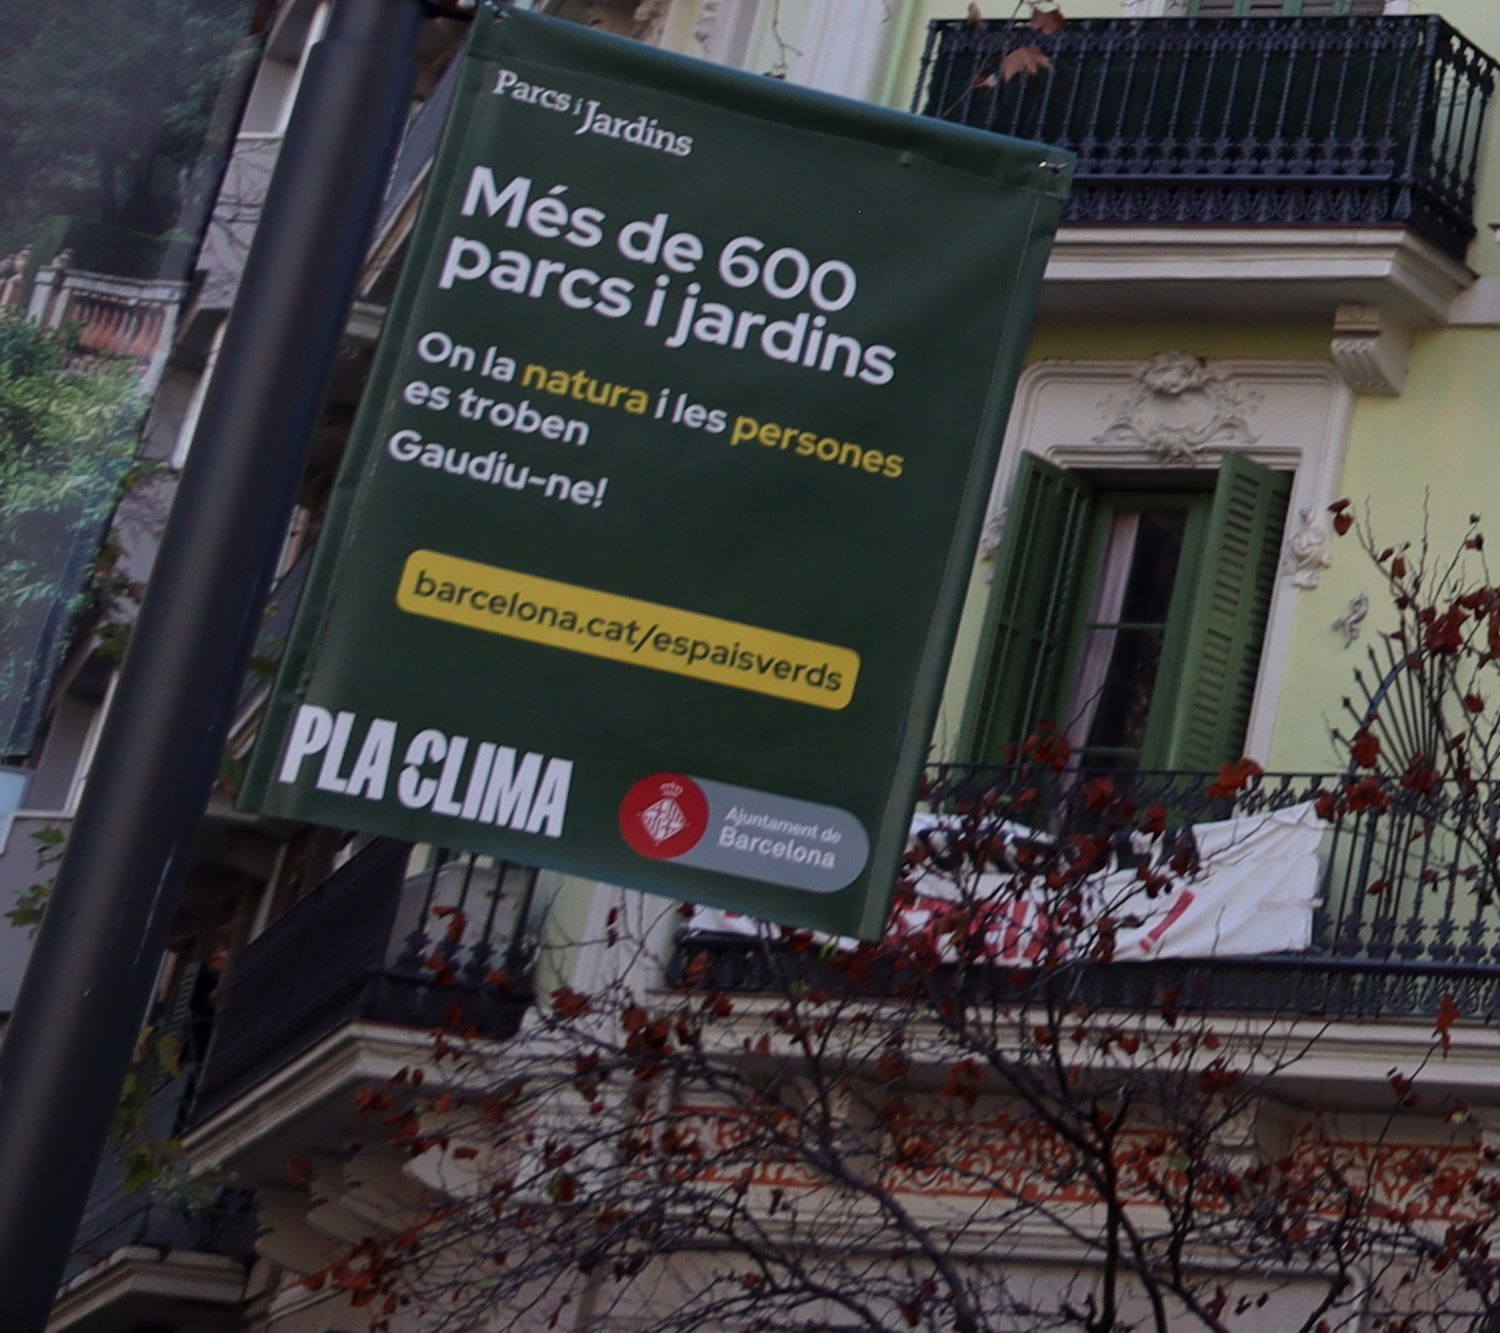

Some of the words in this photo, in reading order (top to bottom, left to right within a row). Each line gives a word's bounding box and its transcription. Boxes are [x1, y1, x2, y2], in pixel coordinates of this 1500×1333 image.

[492, 70, 572, 113] Parcs
[572, 98, 583, 116] i
[575, 100, 694, 157] Jardins
[461, 166, 605, 250] Més
[617, 212, 705, 274] de
[717, 237, 859, 313] 600
[439, 235, 634, 319] parcs
[644, 276, 667, 328] i
[666, 287, 898, 386] jardins
[403, 382, 452, 411] es
[456, 388, 592, 447] troben
[417, 333, 477, 372] On
[480, 347, 517, 384] la
[521, 359, 651, 417] natura
[654, 390, 667, 420] i
[672, 393, 729, 435] les
[730, 415, 905, 479] persones
[388, 430, 610, 509] Gaudiu-ne!
[412, 569, 843, 695] barcelona.cat/espaisverds
[279, 703, 399, 799] PLA
[399, 729, 575, 838] CLIMA
[717, 825, 836, 870] Barcelona
[724, 805, 818, 840] Ajuntament
[821, 827, 842, 844] de
